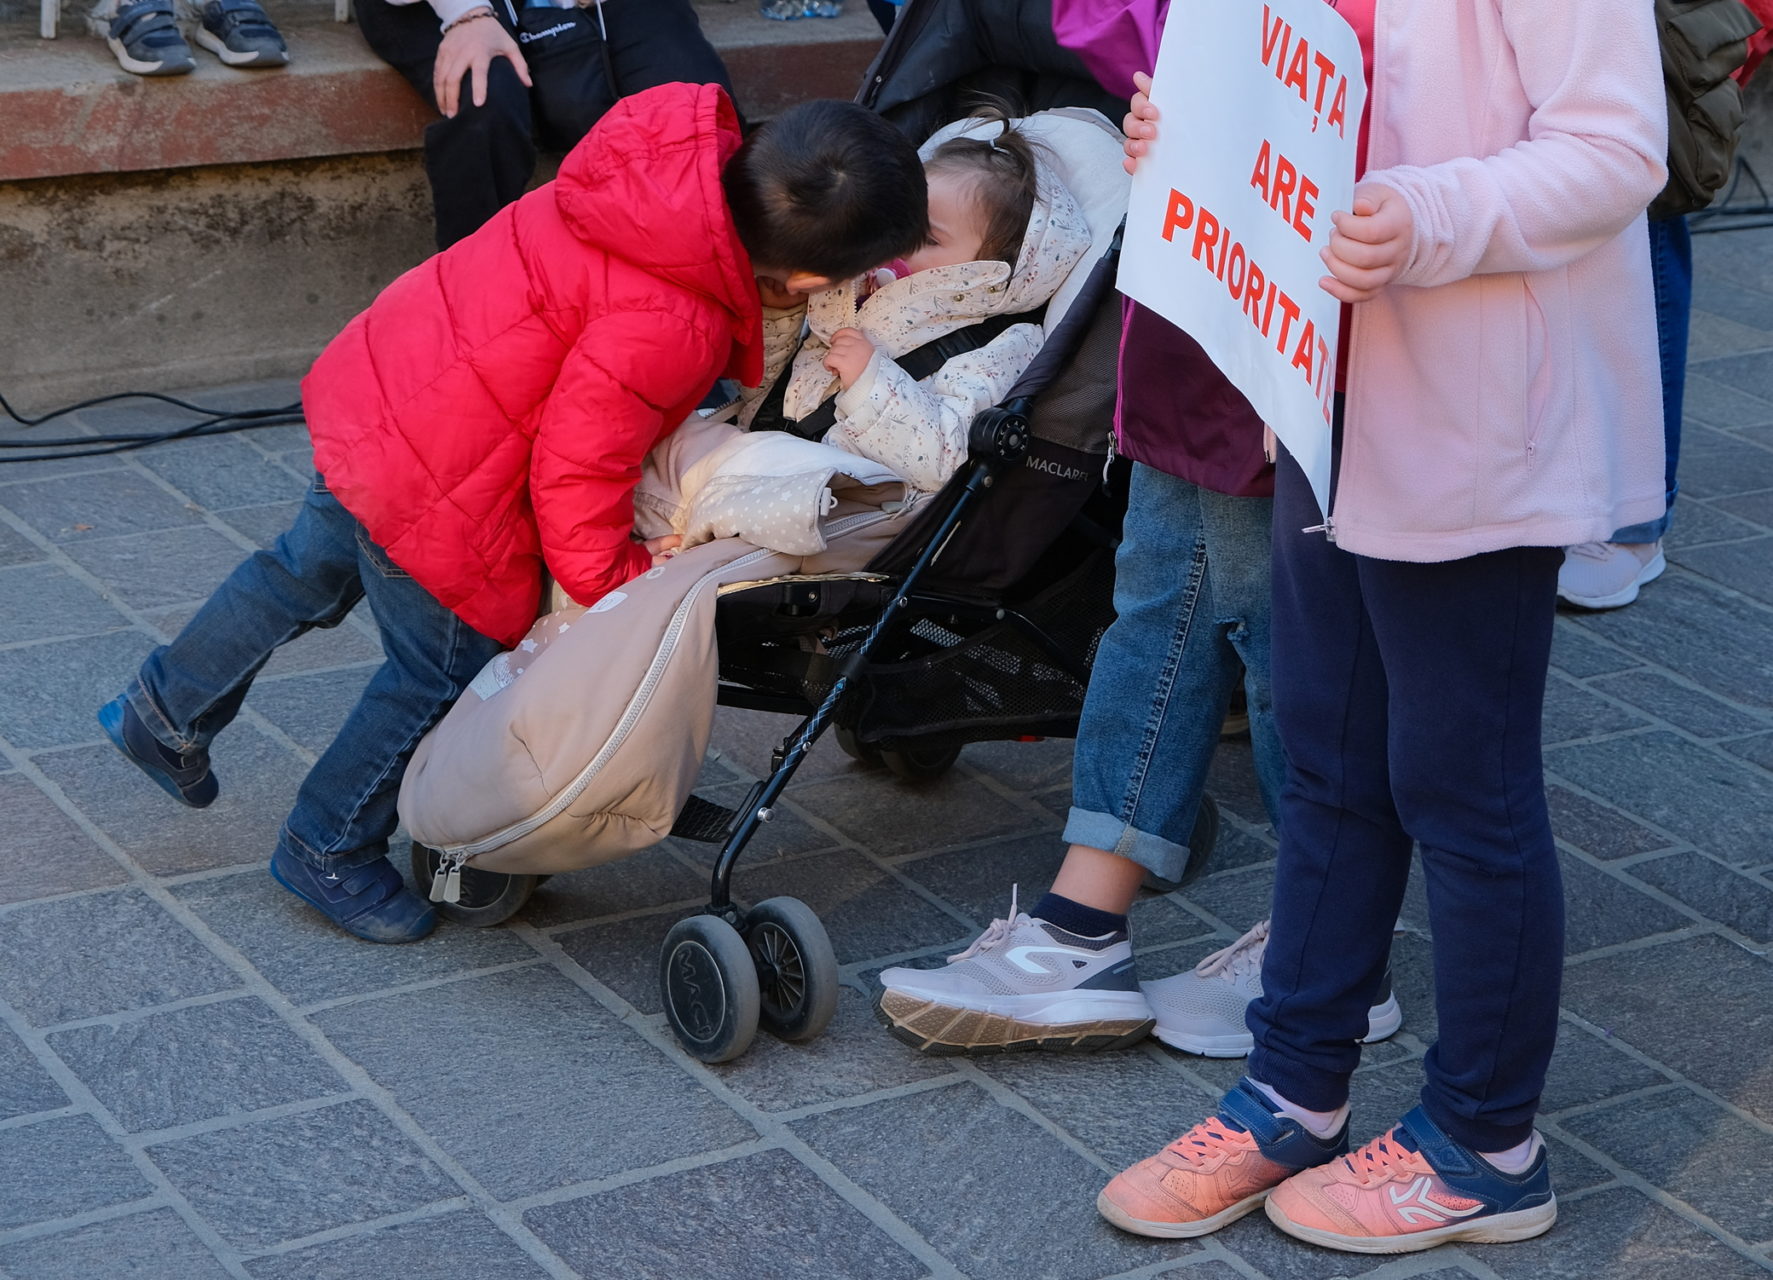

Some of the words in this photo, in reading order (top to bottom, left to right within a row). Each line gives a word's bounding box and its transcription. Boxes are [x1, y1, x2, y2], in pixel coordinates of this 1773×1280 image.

[1261, 3, 1347, 140] VIAȚA
[1250, 138, 1320, 243] ARE
[1162, 187, 1332, 428] PRIORITATE
